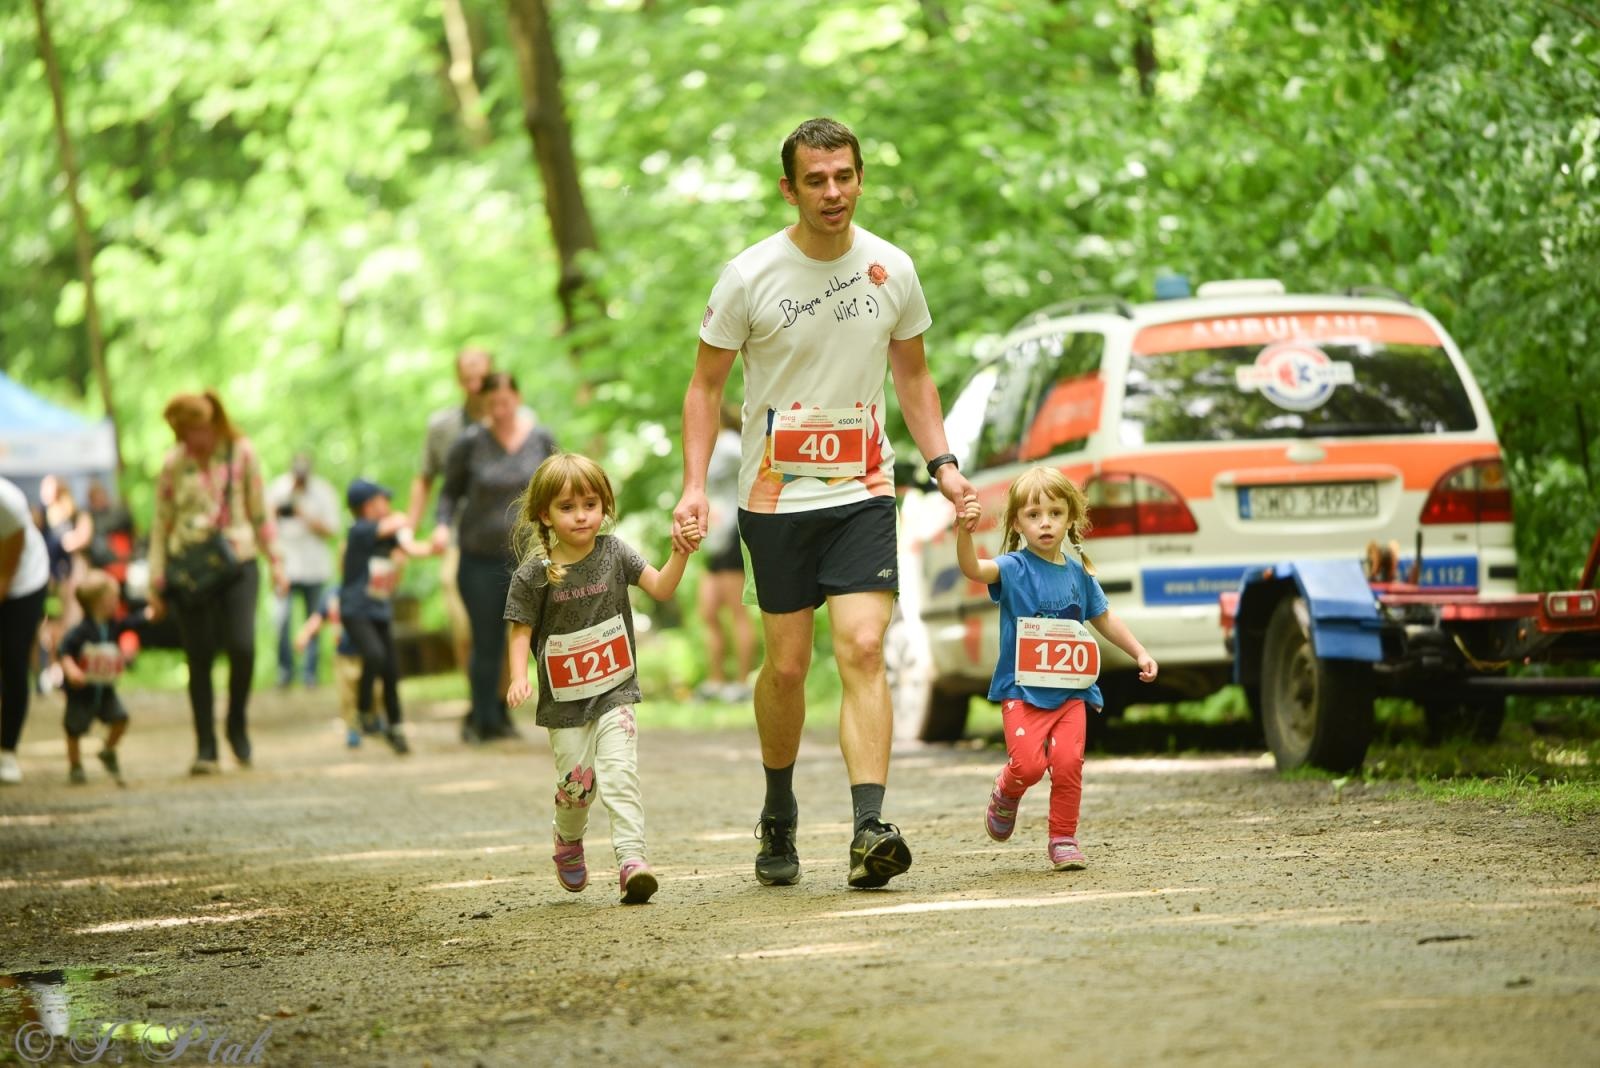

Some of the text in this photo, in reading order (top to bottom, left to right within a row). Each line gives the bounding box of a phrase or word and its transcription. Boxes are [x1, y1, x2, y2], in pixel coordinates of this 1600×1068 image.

[798, 433, 840, 462] 40
[602, 629, 617, 638] 4500
[562, 644, 620, 684] 121
[1034, 642, 1089, 672] 120
